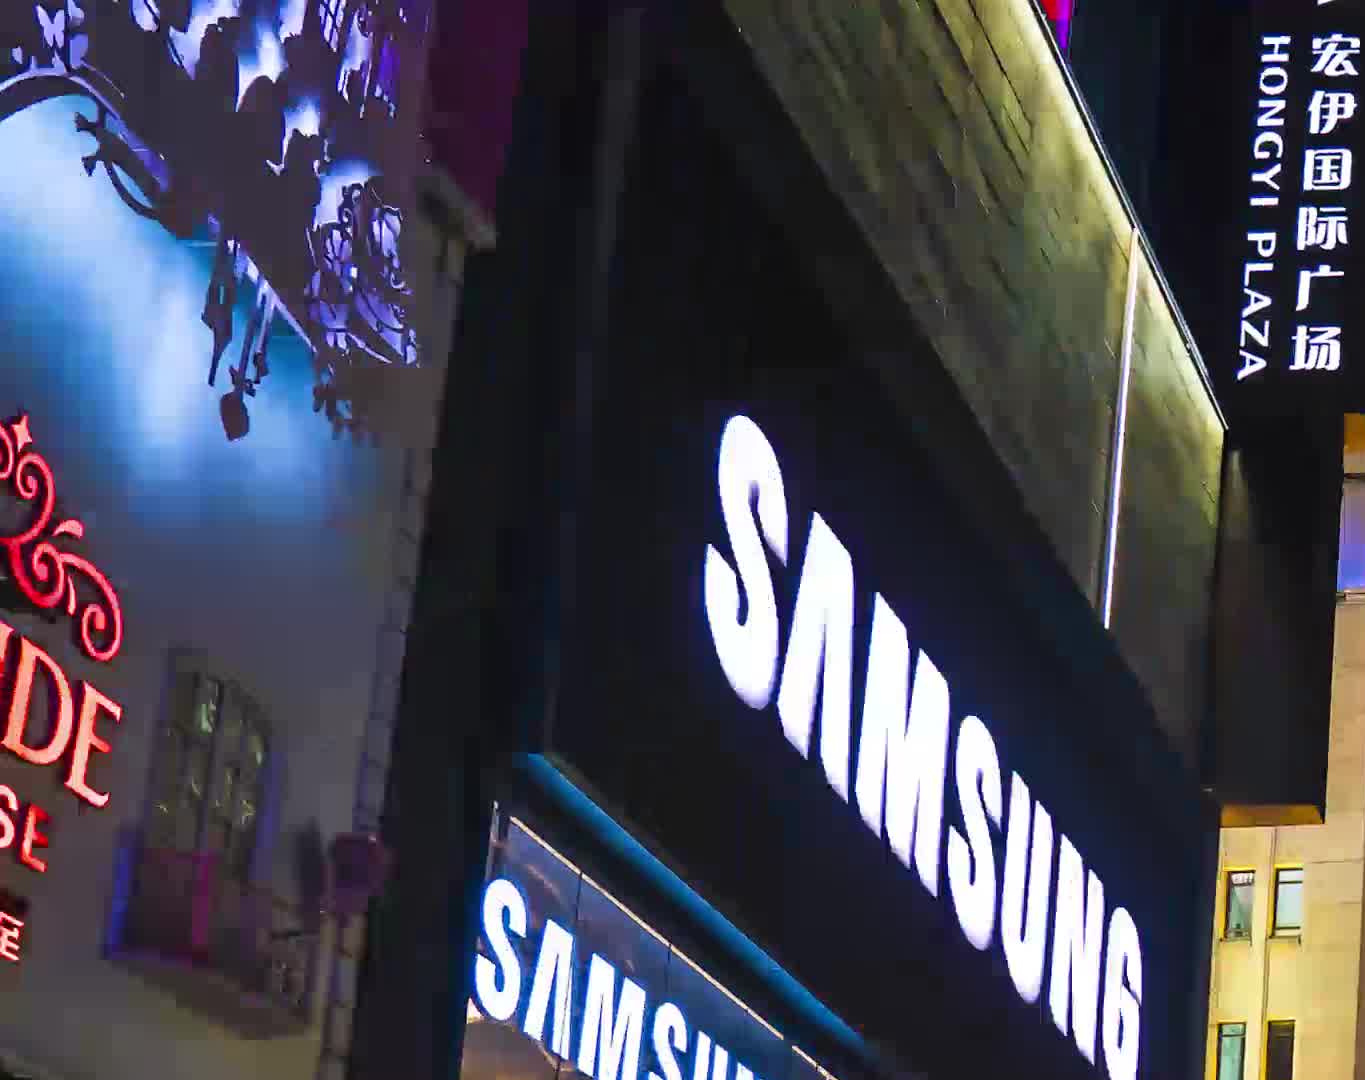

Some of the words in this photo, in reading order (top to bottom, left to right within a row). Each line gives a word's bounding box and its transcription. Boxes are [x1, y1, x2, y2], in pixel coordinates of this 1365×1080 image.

[1249, 34, 1291, 207] HONGYI
[1289, 33, 1361, 372] 宏伊国际广场
[1237, 232, 1277, 381] PLAZA
